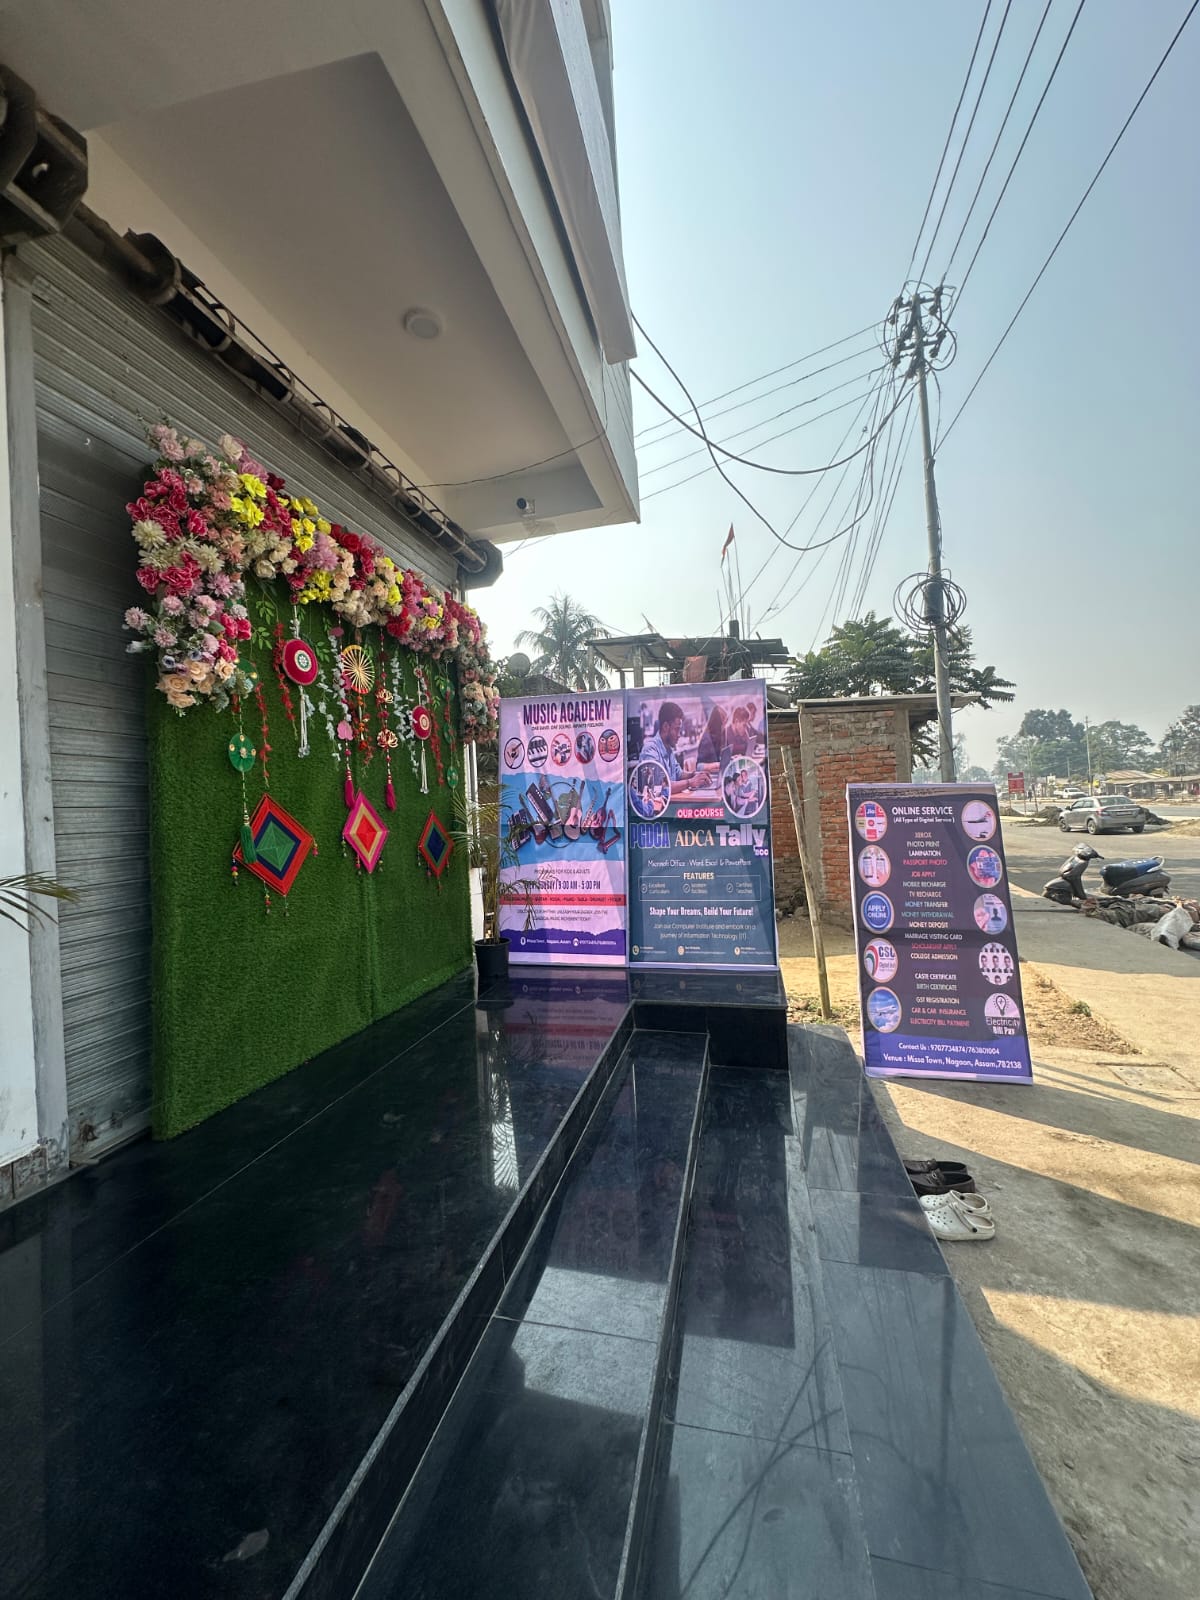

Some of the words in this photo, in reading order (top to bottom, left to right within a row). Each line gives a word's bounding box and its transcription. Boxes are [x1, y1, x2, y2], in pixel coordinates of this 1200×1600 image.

[524, 702, 557, 725] MUSIC
[560, 699, 611, 722] ACADEMY
[678, 809, 693, 818] OUR
[694, 808, 724, 817] COURSE
[892, 807, 920, 815] ONLINE
[922, 806, 953, 815] SERVICE
[675, 829, 714, 847] ADCA
[716, 824, 766, 847] Tally
[570, 881, 577, 890] AM
[593, 881, 600, 890] PM
[650, 907, 665, 916] Shape
[666, 907, 679, 915] Your
[681, 907, 702, 916] Dreams,
[704, 907, 718, 915] Build
[720, 907, 732, 915] Your
[734, 907, 753, 915] Future!
[986, 1017, 1020, 1028] Electricity
[884, 1053, 902, 1061] Venue
[907, 1055, 924, 1063] Missa
[925, 1056, 945, 1066] Town,
[946, 1057, 973, 1067] Nagaon,
